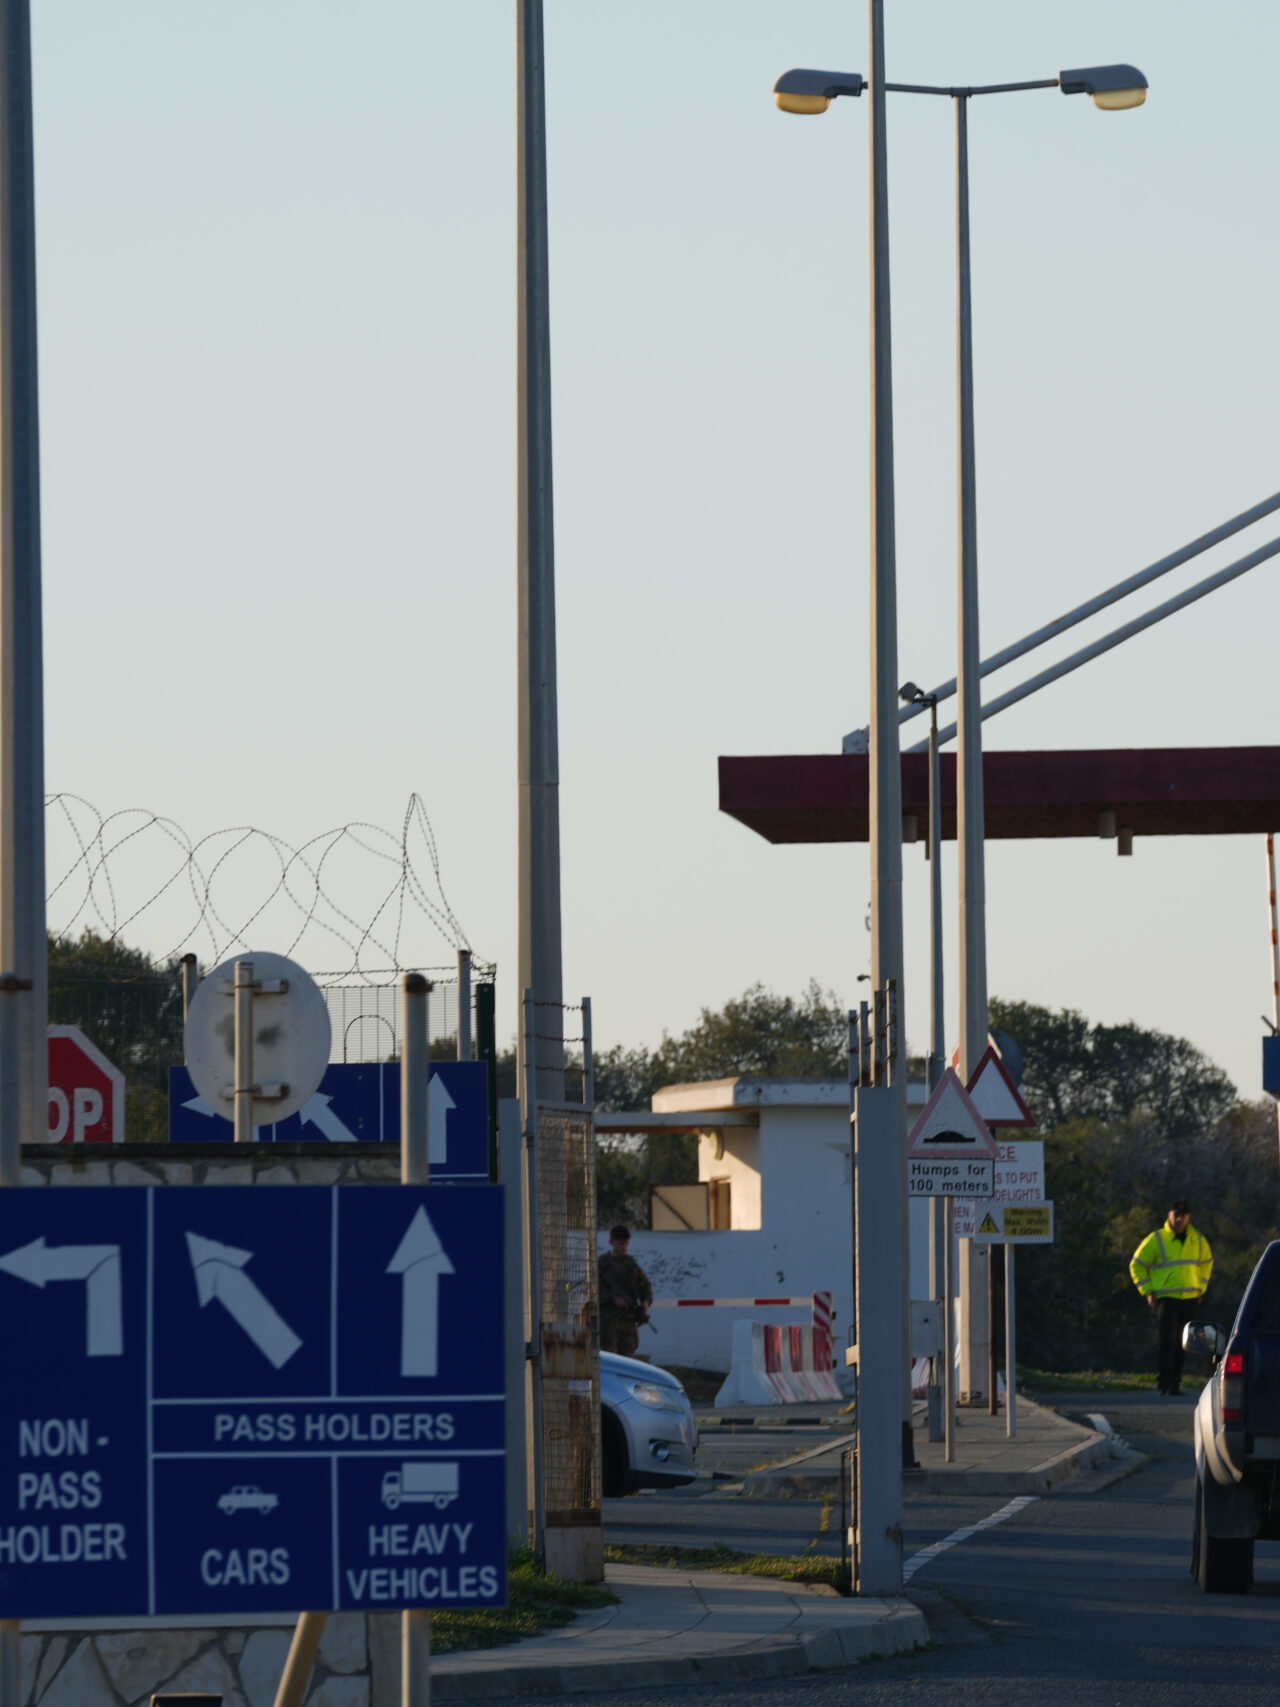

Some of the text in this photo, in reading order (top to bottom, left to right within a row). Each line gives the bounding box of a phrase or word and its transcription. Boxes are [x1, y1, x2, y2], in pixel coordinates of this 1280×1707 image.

[910, 1179, 989, 1192] 100 meters
[911, 1163, 986, 1177] Humps for
[1005, 1171, 1018, 1184] TO
[1019, 1171, 1039, 1183] PUT
[19, 1418, 89, 1457] NON
[214, 1413, 455, 1442] PASS HOLDERS
[18, 1471, 102, 1511] PASS
[0, 1523, 127, 1564] HOLDER
[368, 1523, 473, 1556] HEAVY
[201, 1548, 291, 1586] CARS
[346, 1566, 499, 1600] VEHICLES
